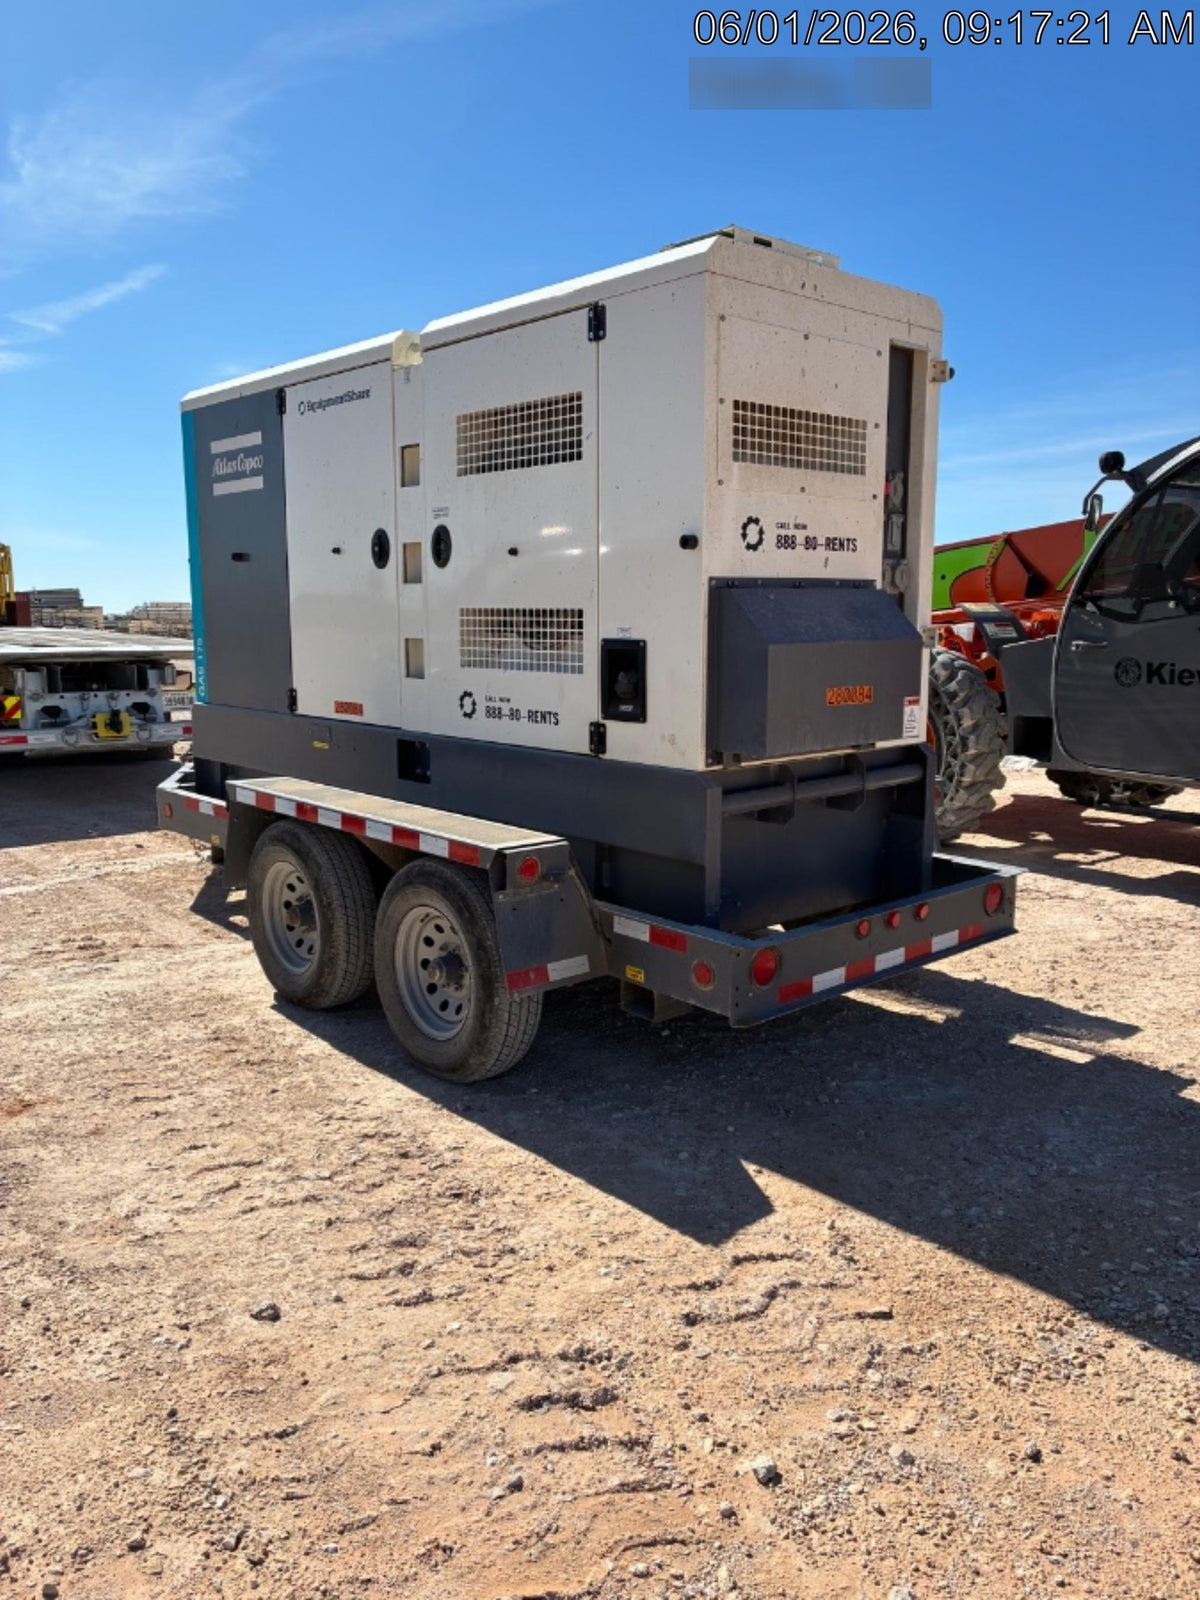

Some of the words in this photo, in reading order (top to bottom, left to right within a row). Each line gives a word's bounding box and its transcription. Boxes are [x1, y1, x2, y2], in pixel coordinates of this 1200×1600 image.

[211, 457, 237, 477] Atlas
[237, 453, 264, 475] Copco
[776, 534, 858, 553] 888-80-RENTS
[485, 705, 559, 726] 888-80-RENTS
